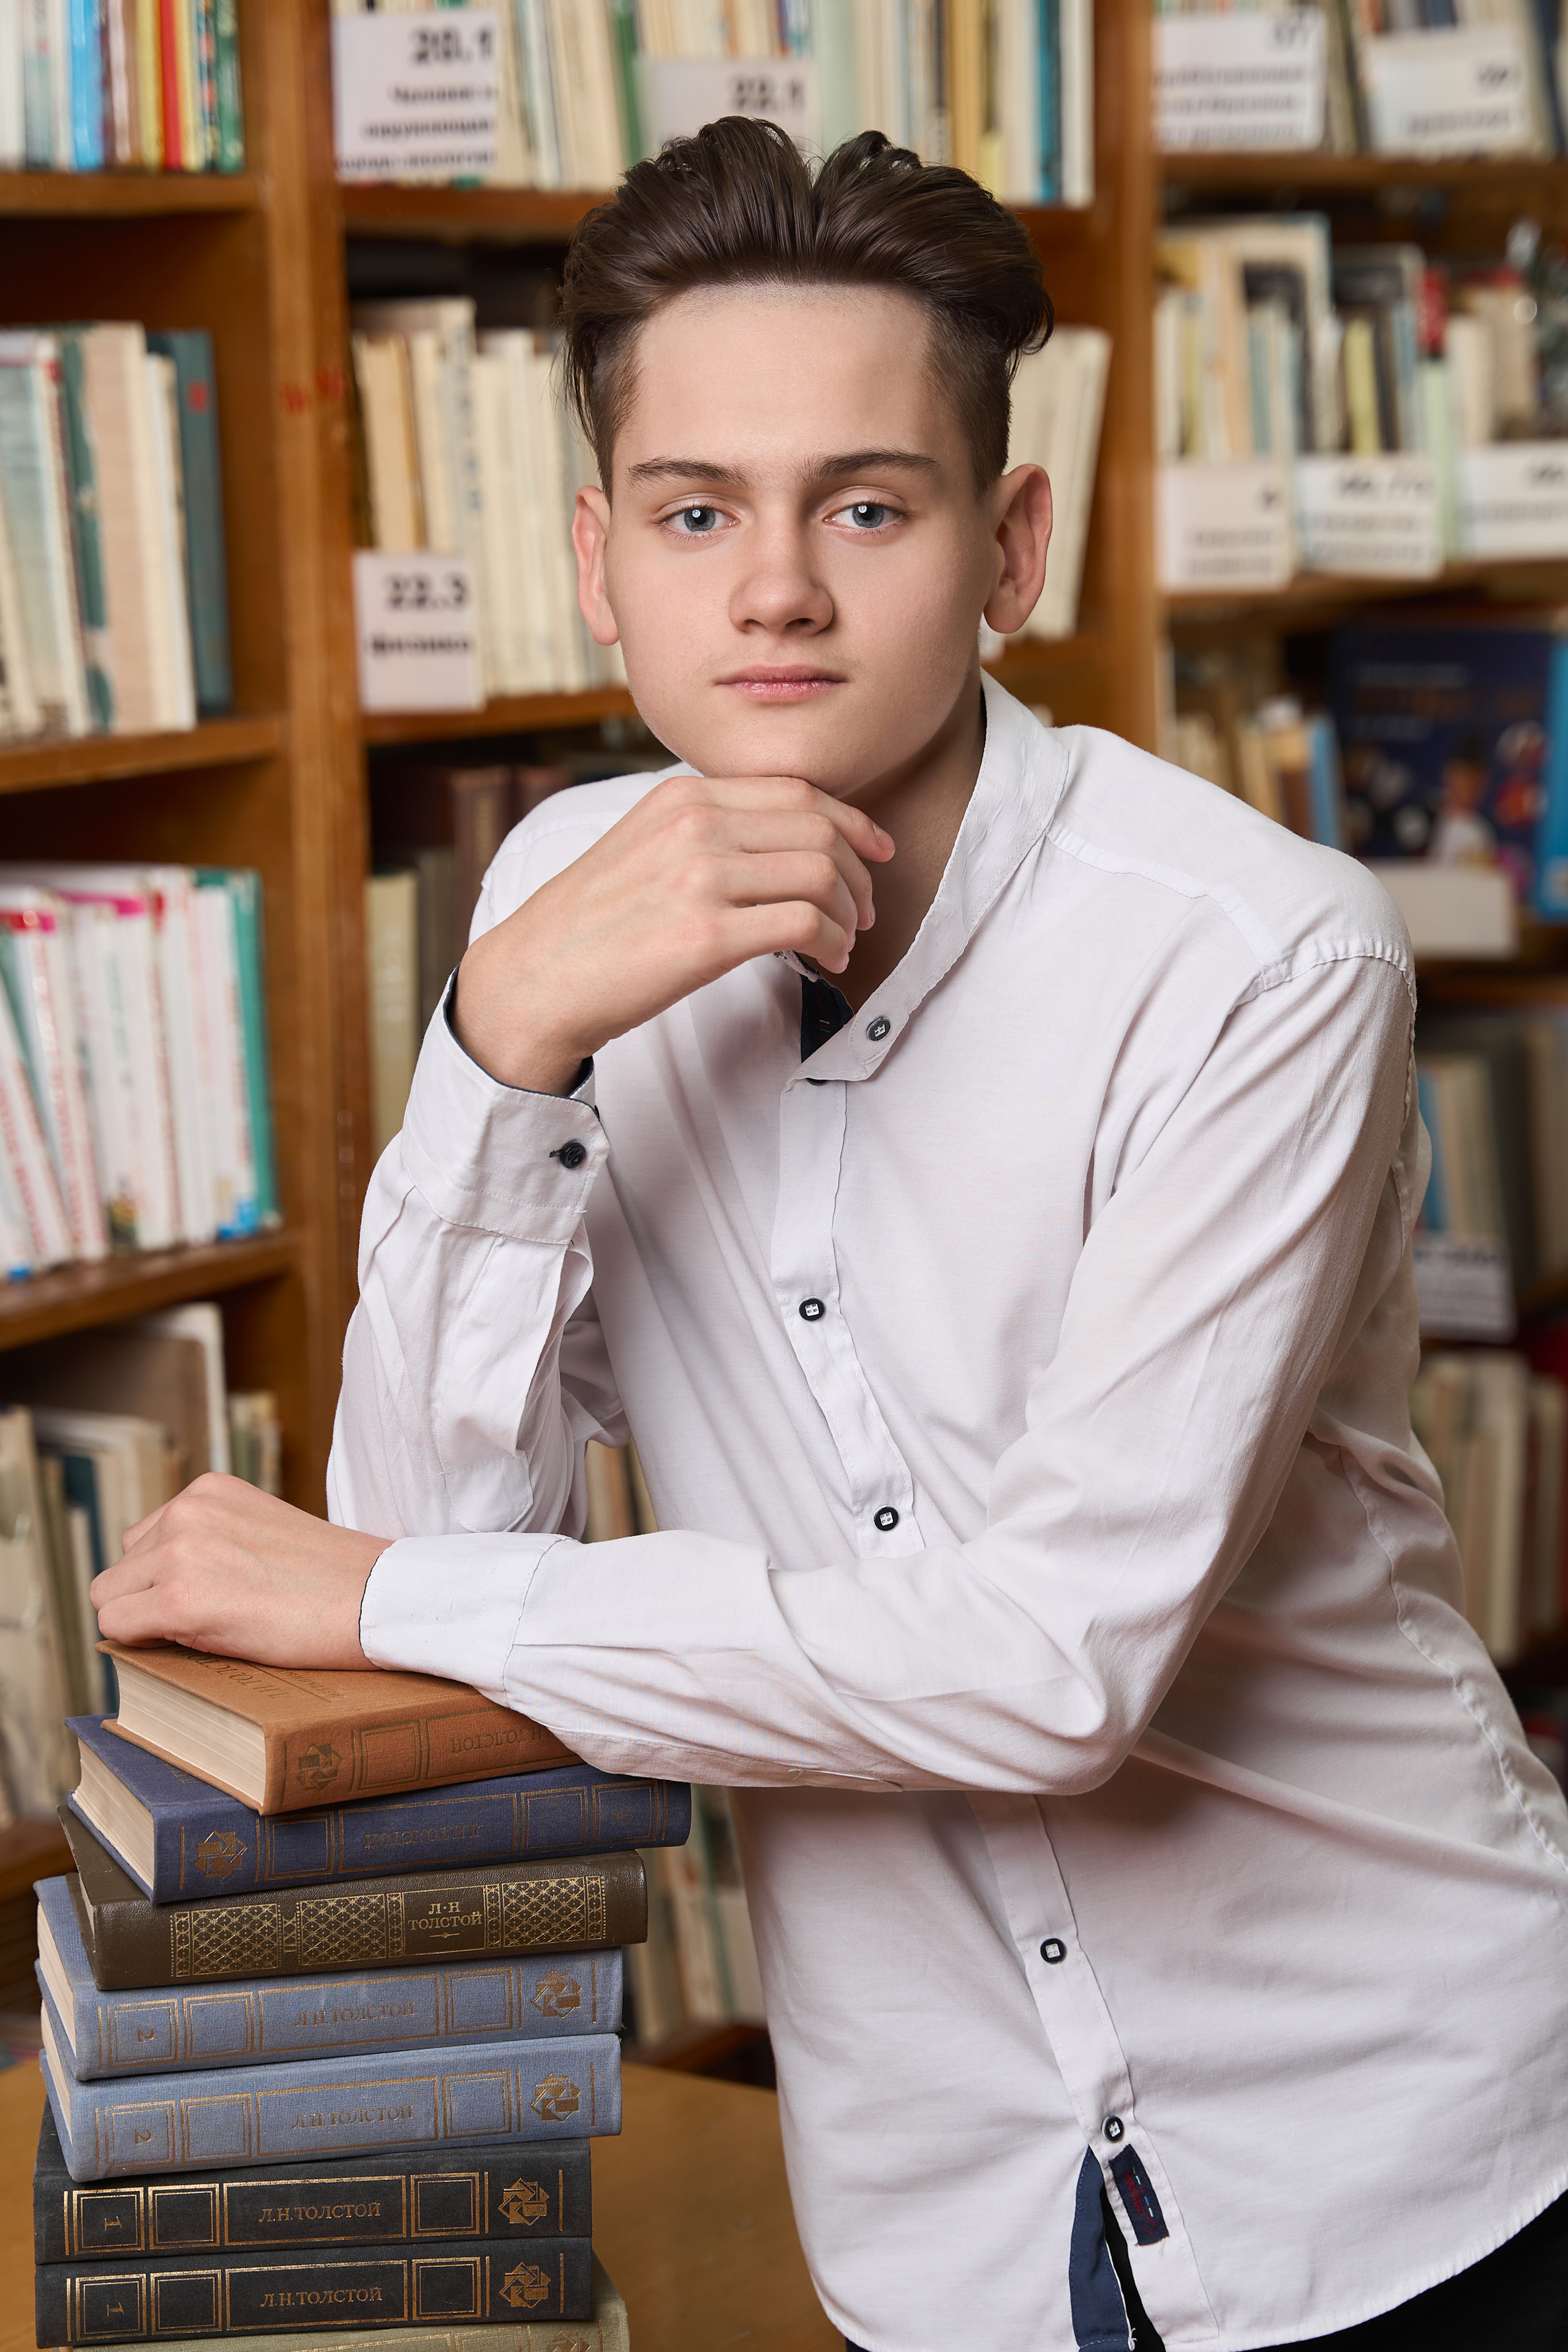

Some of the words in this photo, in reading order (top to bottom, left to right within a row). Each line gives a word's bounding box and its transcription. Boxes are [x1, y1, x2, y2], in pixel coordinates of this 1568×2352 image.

[386, 575, 469, 610] 22.3
[407, 1911, 483, 1931] ТОЛСТОЙ
[138, 2027, 155, 2043] 2
[292, 2104, 413, 2129] Л.Н.ТОЛСТОЙ
[135, 2130, 153, 2145] 2
[258, 2201, 381, 2223] Л.Н.ТОЛСТОЙ
[104, 2215, 122, 2231] 1
[260, 2286, 382, 2307] Л.Н.ТОЛСТОЙ
[107, 2301, 124, 2316] 1
